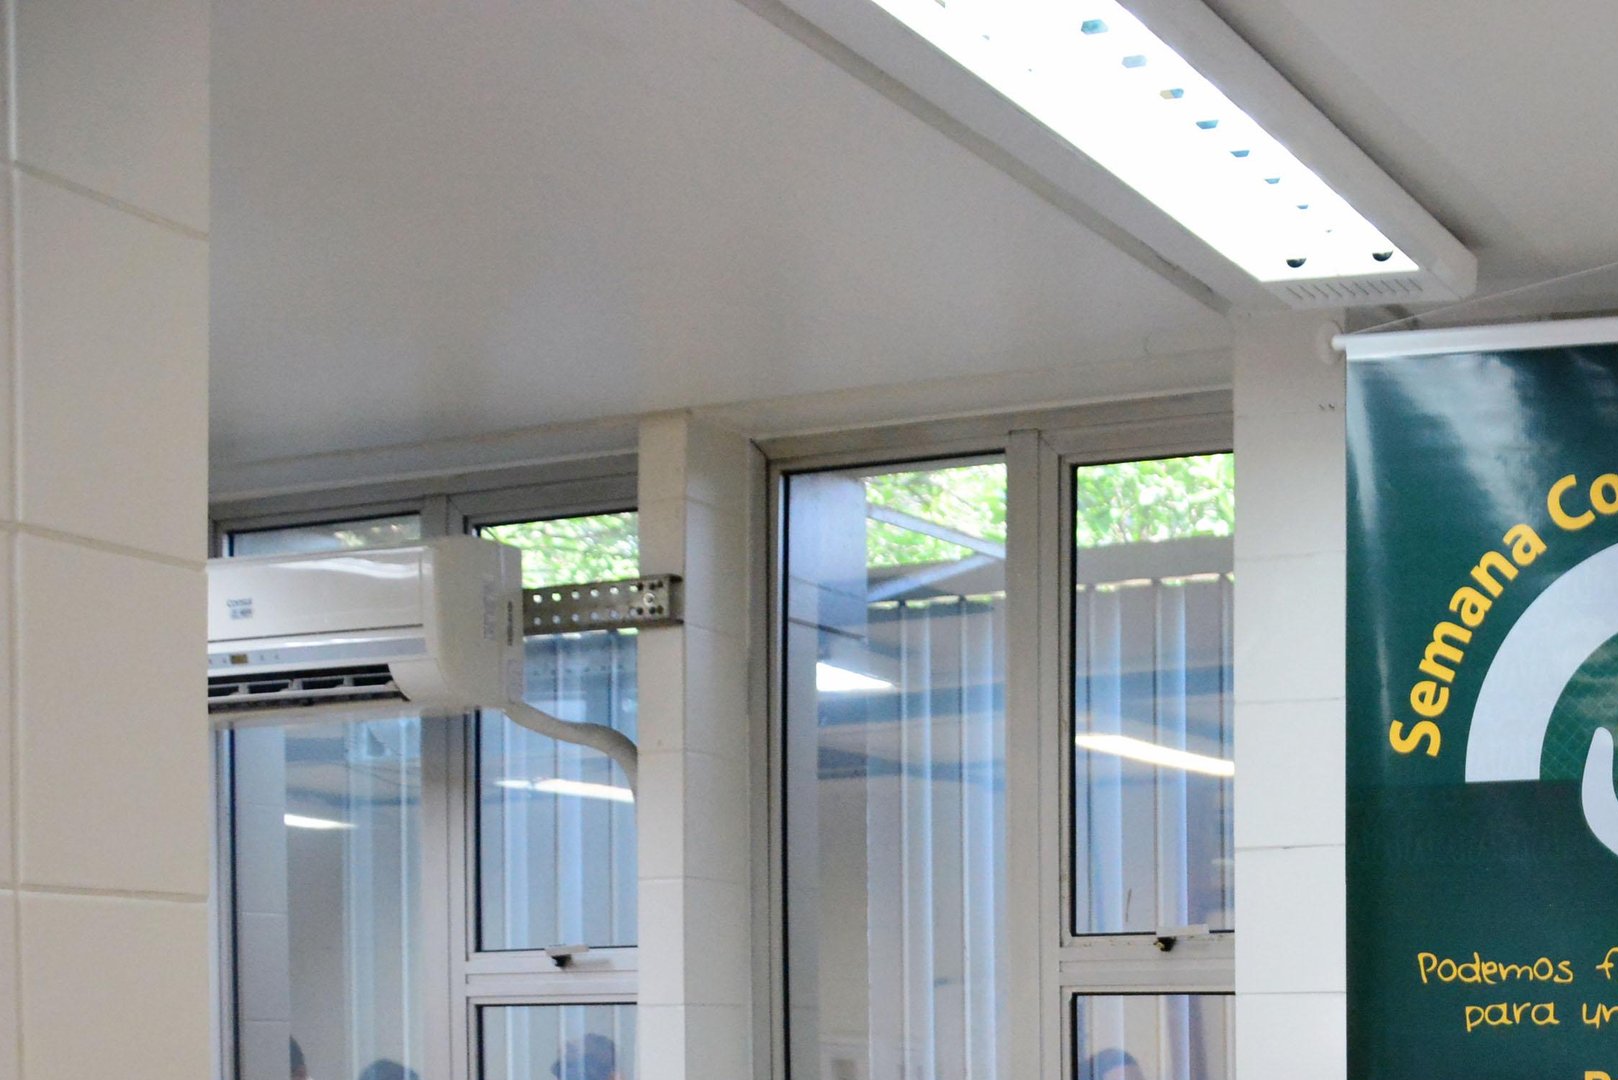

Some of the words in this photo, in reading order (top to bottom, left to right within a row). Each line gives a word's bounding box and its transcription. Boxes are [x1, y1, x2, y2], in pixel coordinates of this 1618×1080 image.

[1389, 524, 1546, 757] Semana
[1417, 951, 1574, 985] Podemos
[1465, 1001, 1560, 1032] para
